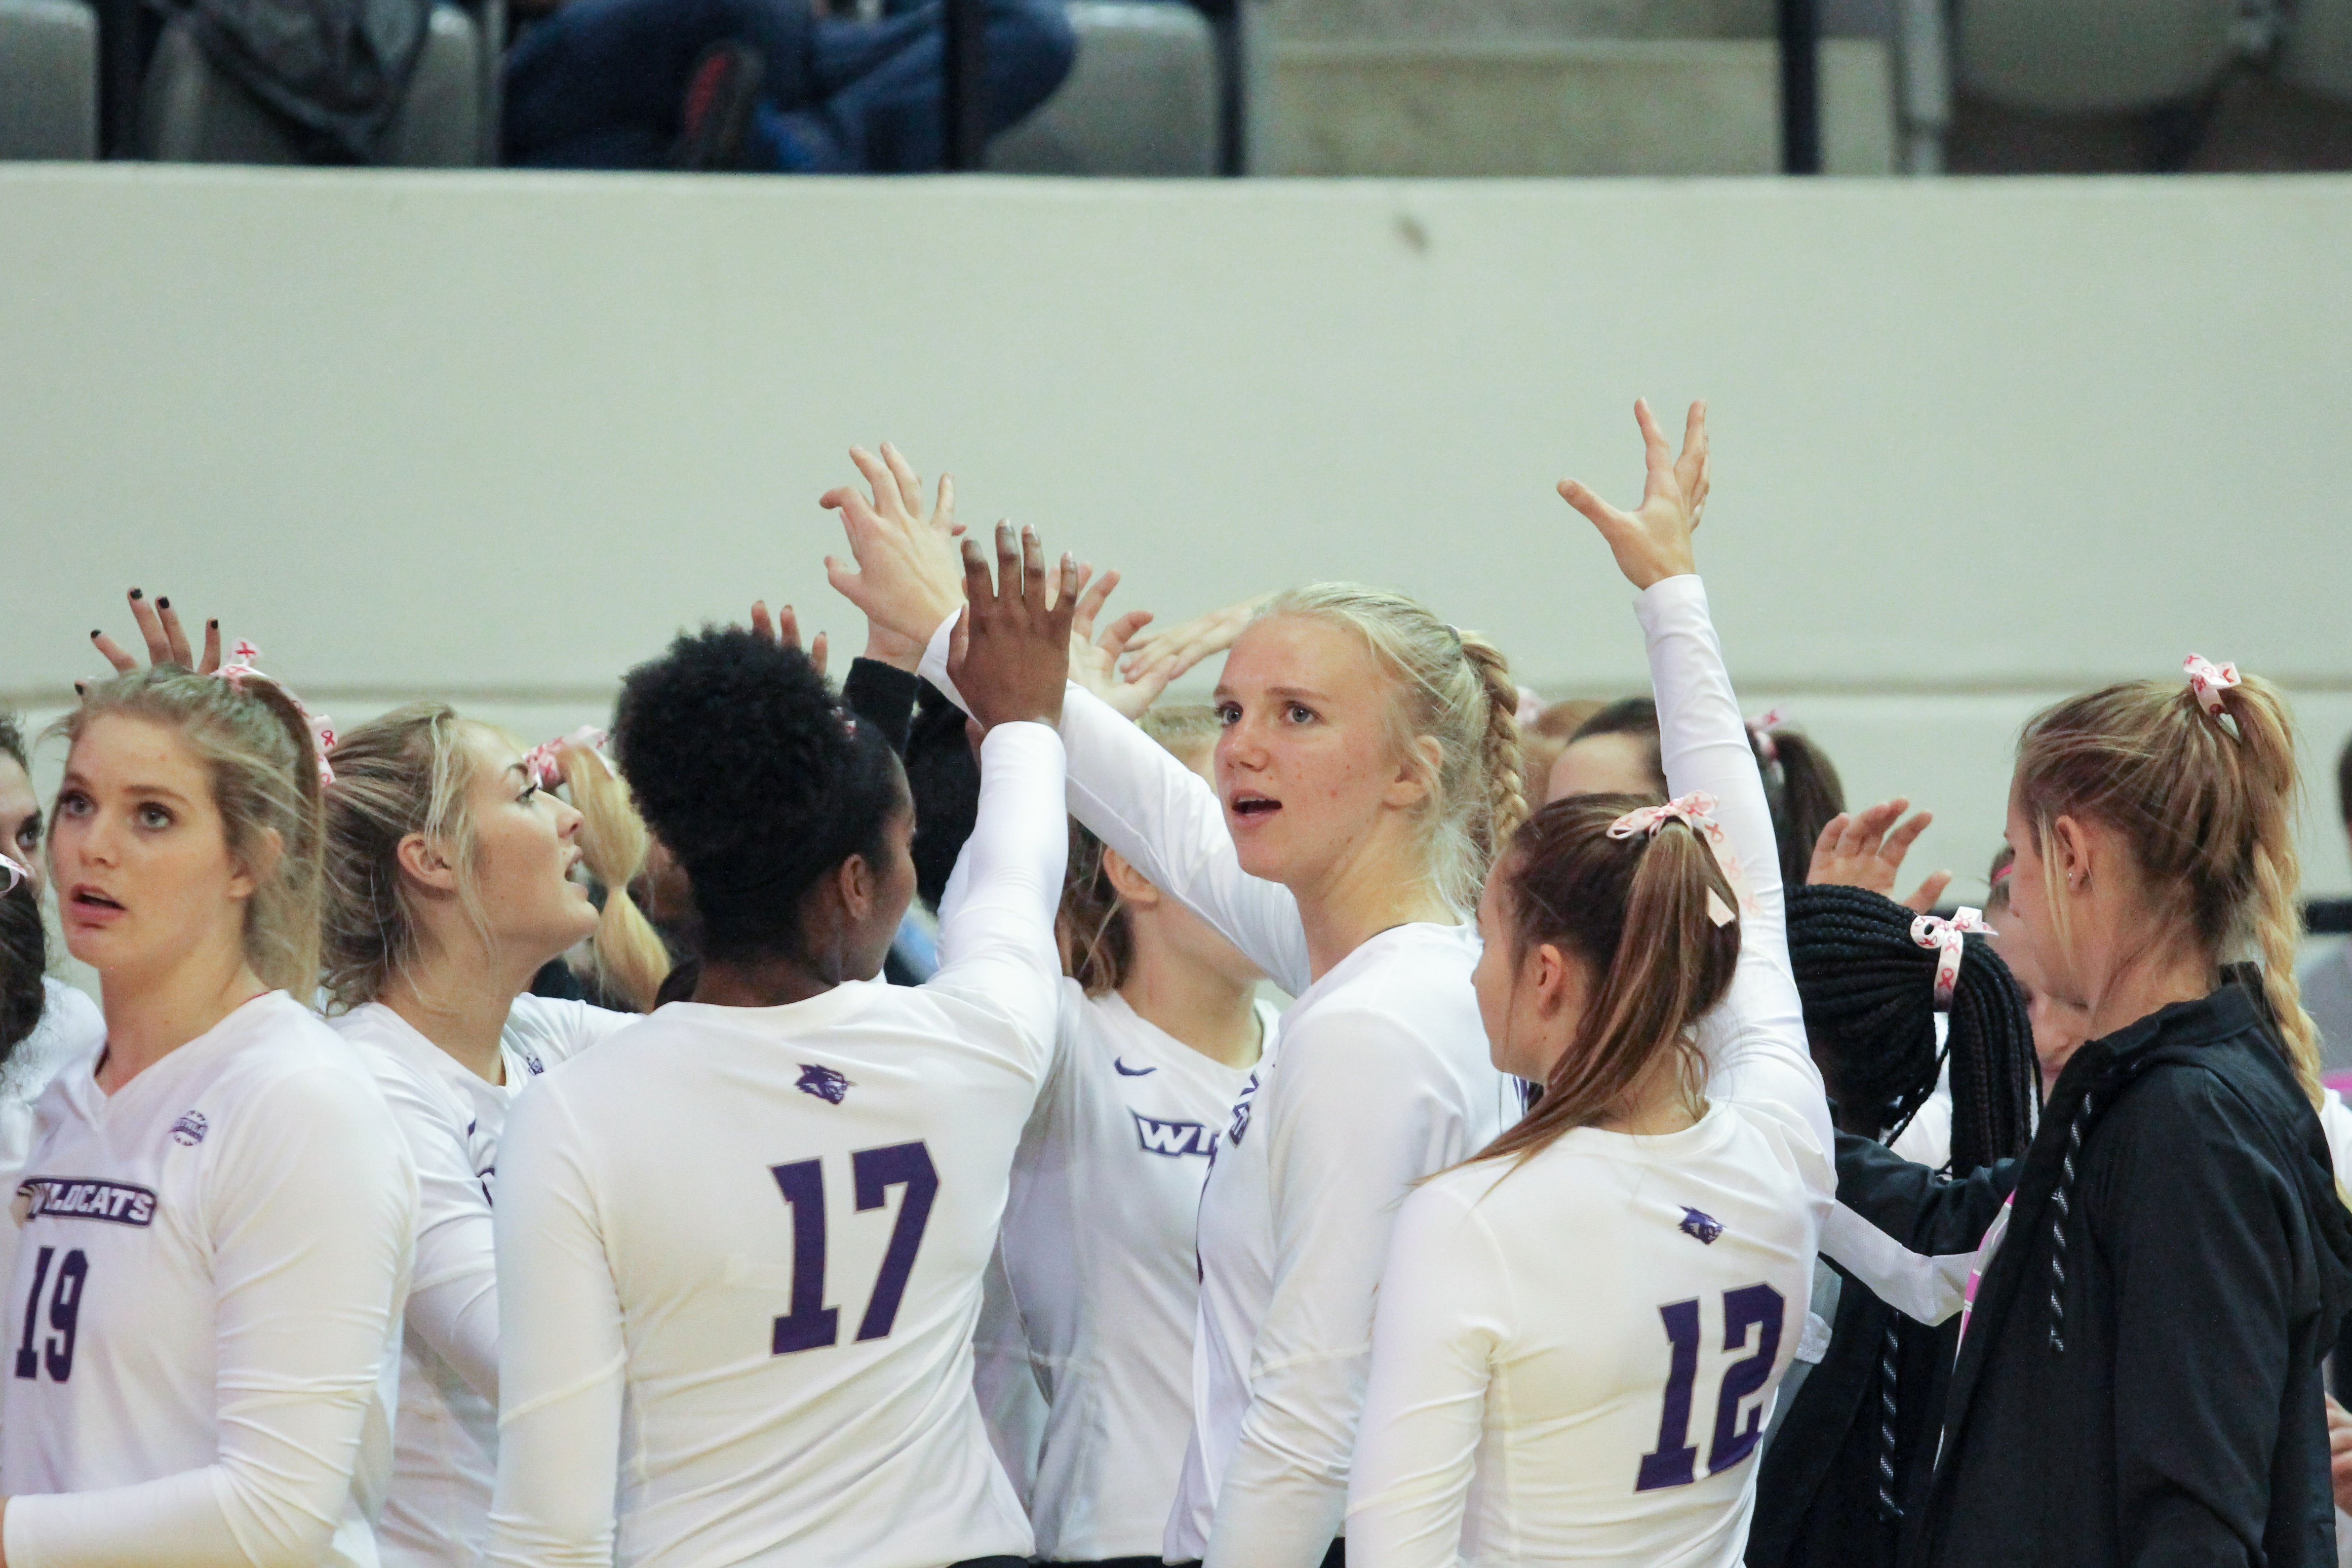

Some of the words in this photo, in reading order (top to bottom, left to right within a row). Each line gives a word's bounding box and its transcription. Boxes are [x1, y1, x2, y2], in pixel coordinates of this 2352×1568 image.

[15, 1245, 89, 1383] 19
[768, 1139, 940, 1357] 17
[1634, 1281, 1786, 1494] 12
